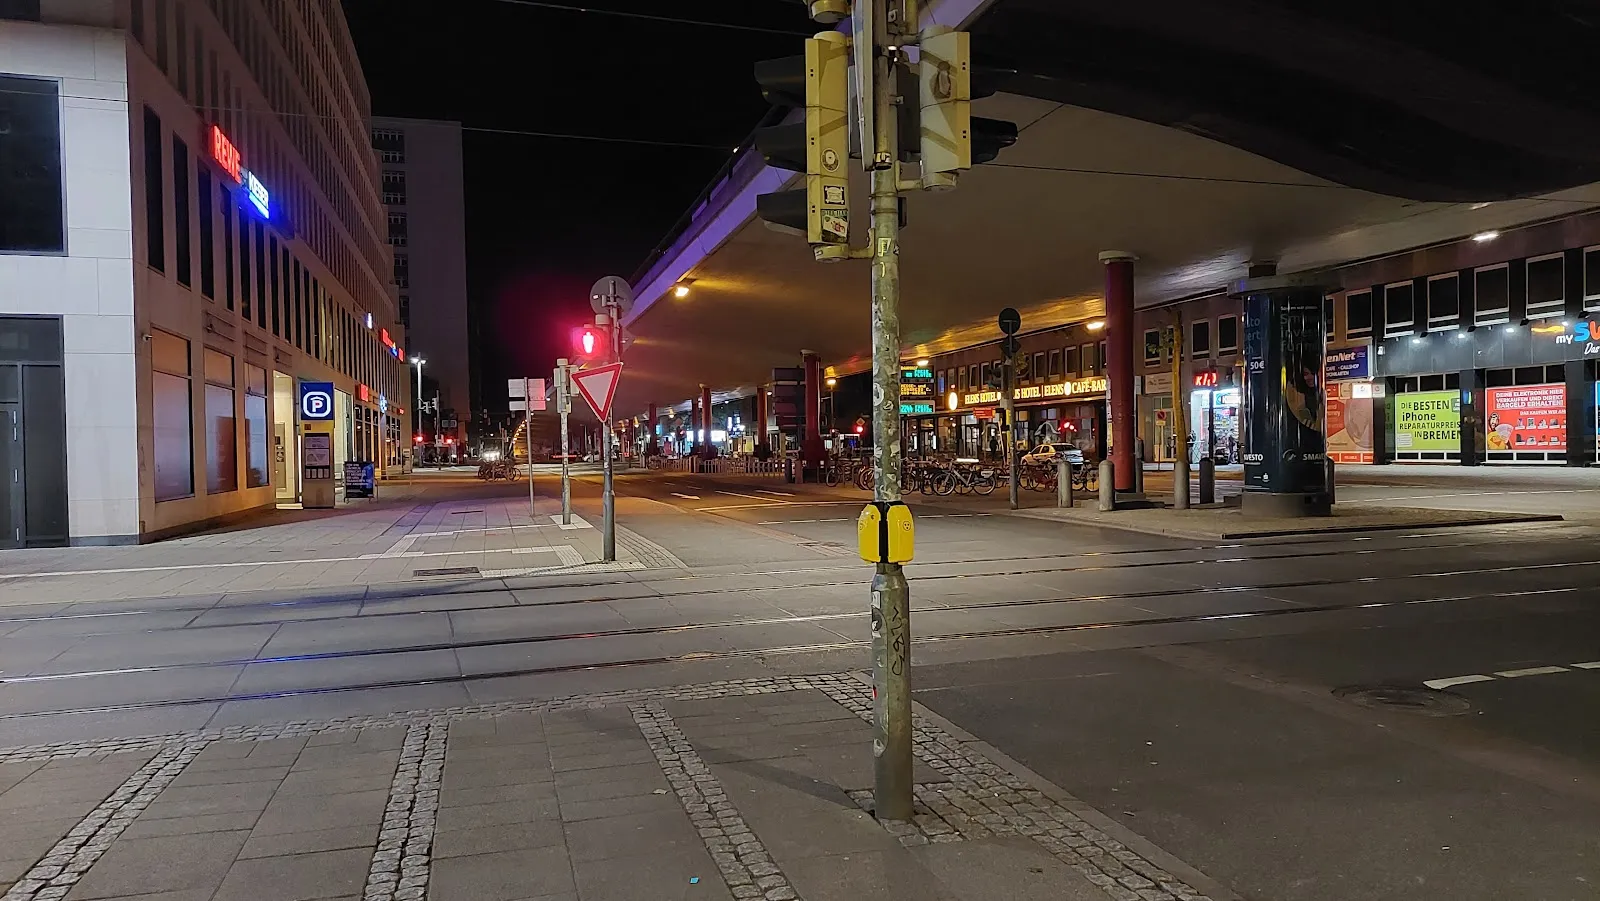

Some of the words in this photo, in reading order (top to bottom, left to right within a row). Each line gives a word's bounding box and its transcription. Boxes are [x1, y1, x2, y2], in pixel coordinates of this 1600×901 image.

[980, 391, 997, 402] HOTEL
[1021, 386, 1041, 398] HOTEL
[1044, 384, 1064, 396] ELENS
[1513, 389, 1549, 397] ELEKTRONIK
[1413, 400, 1450, 411] BESTEN
[1402, 412, 1436, 421] iPhone
